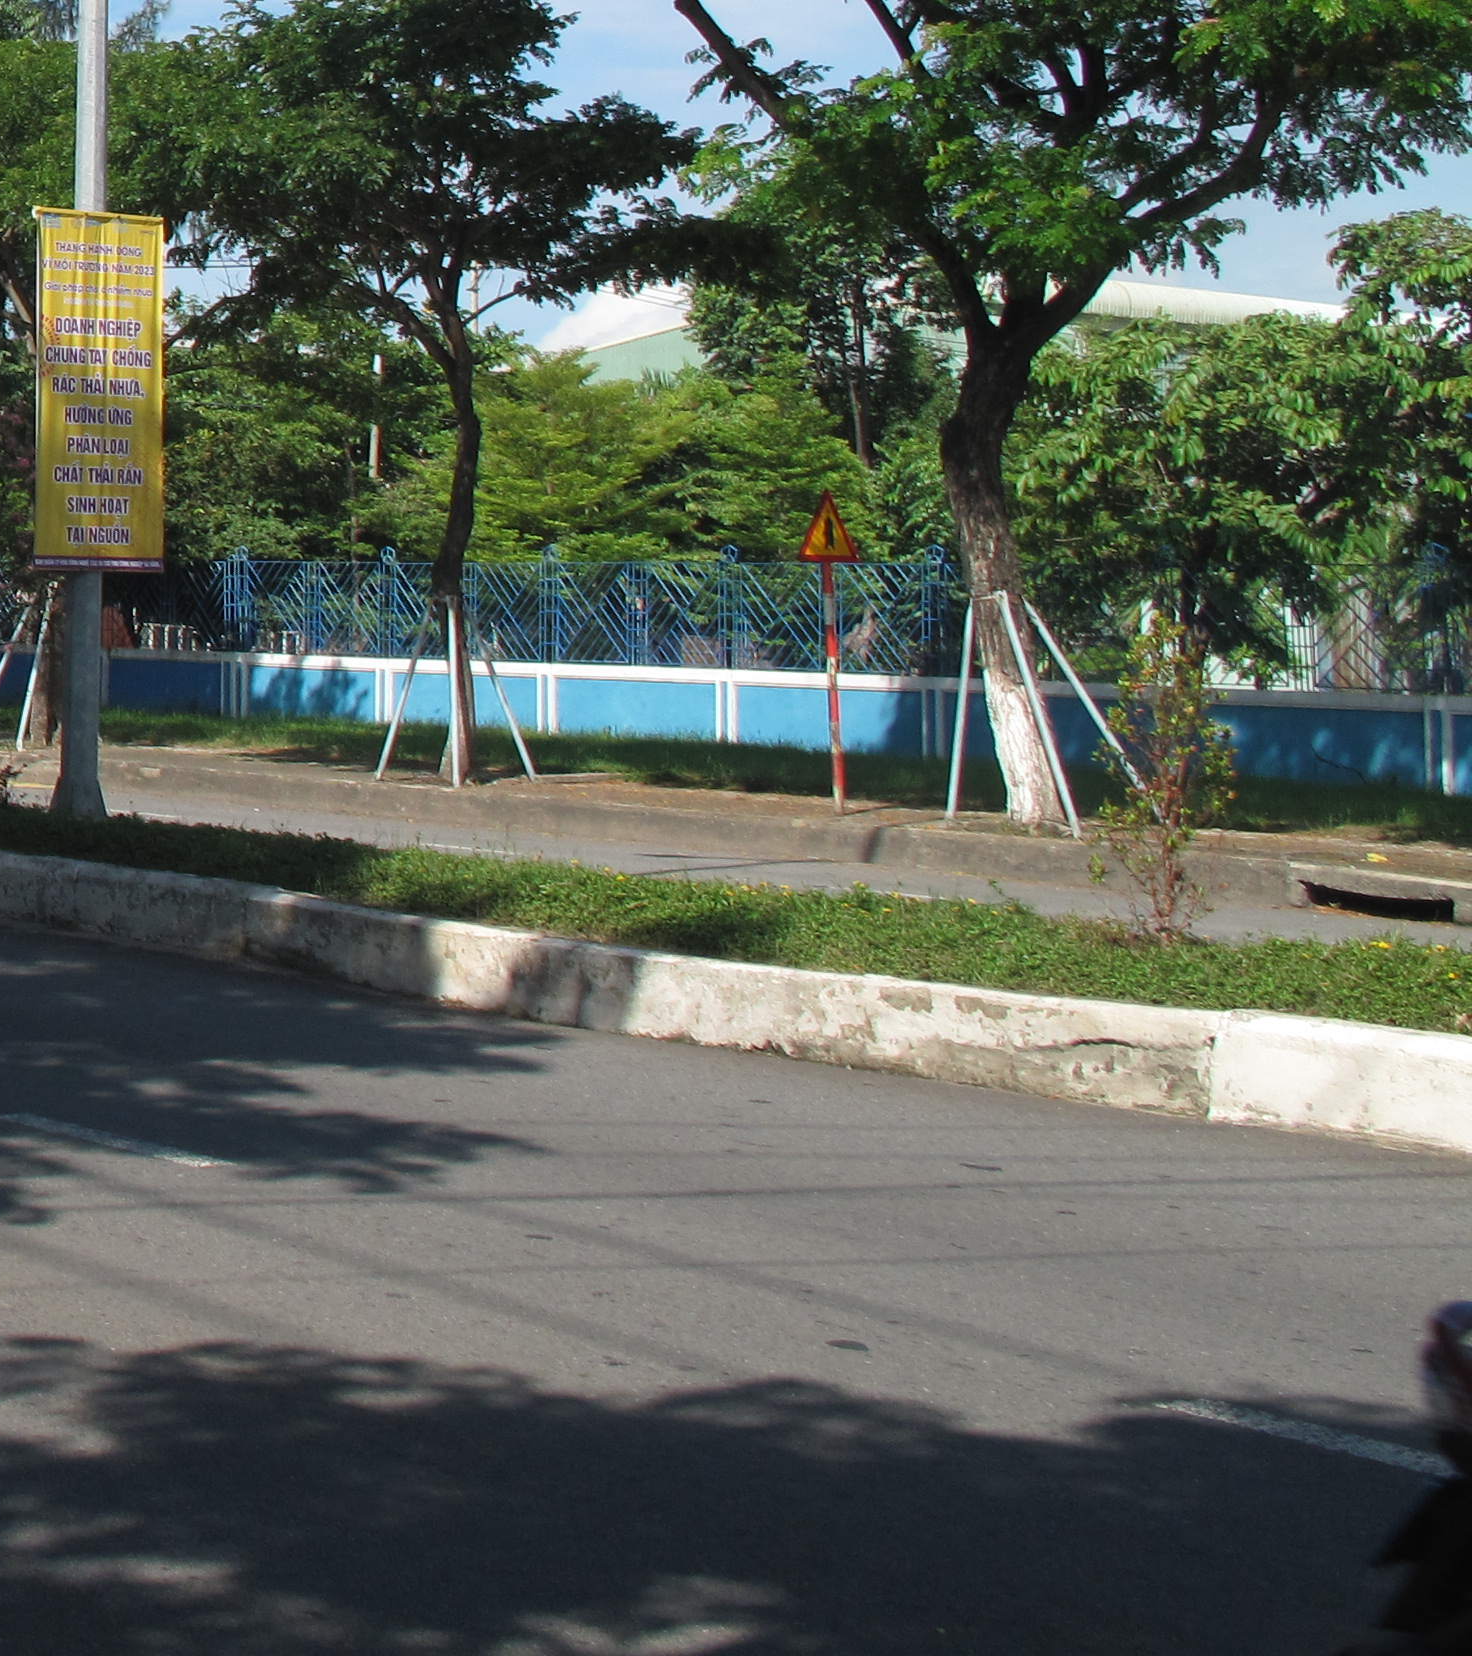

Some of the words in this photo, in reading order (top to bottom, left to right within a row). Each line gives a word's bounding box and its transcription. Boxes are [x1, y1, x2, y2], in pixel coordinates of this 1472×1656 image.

[55, 239, 87, 253] THÁNG
[133, 265, 156, 276] 2023
[55, 317, 95, 335] DOANH
[99, 319, 141, 340] NGHIỆP
[45, 346, 85, 364] CHUNG
[89, 349, 107, 365] TAY
[112, 345, 152, 367] CHỐNG
[52, 374, 76, 392] RÁC
[80, 373, 106, 394] THẢI
[108, 406, 132, 425] ỨNG
[67, 434, 100, 454] PHÂN
[103, 438, 129, 458] LOẠI
[54, 461, 84, 482] CHẤT
[88, 462, 113, 484] THẢI
[117, 462, 142, 485] RẮN
[67, 496, 96, 513] SINH
[100, 498, 129, 517] HOẠT
[66, 526, 84, 546] TẠI
[88, 523, 129, 544] NGUỒN
